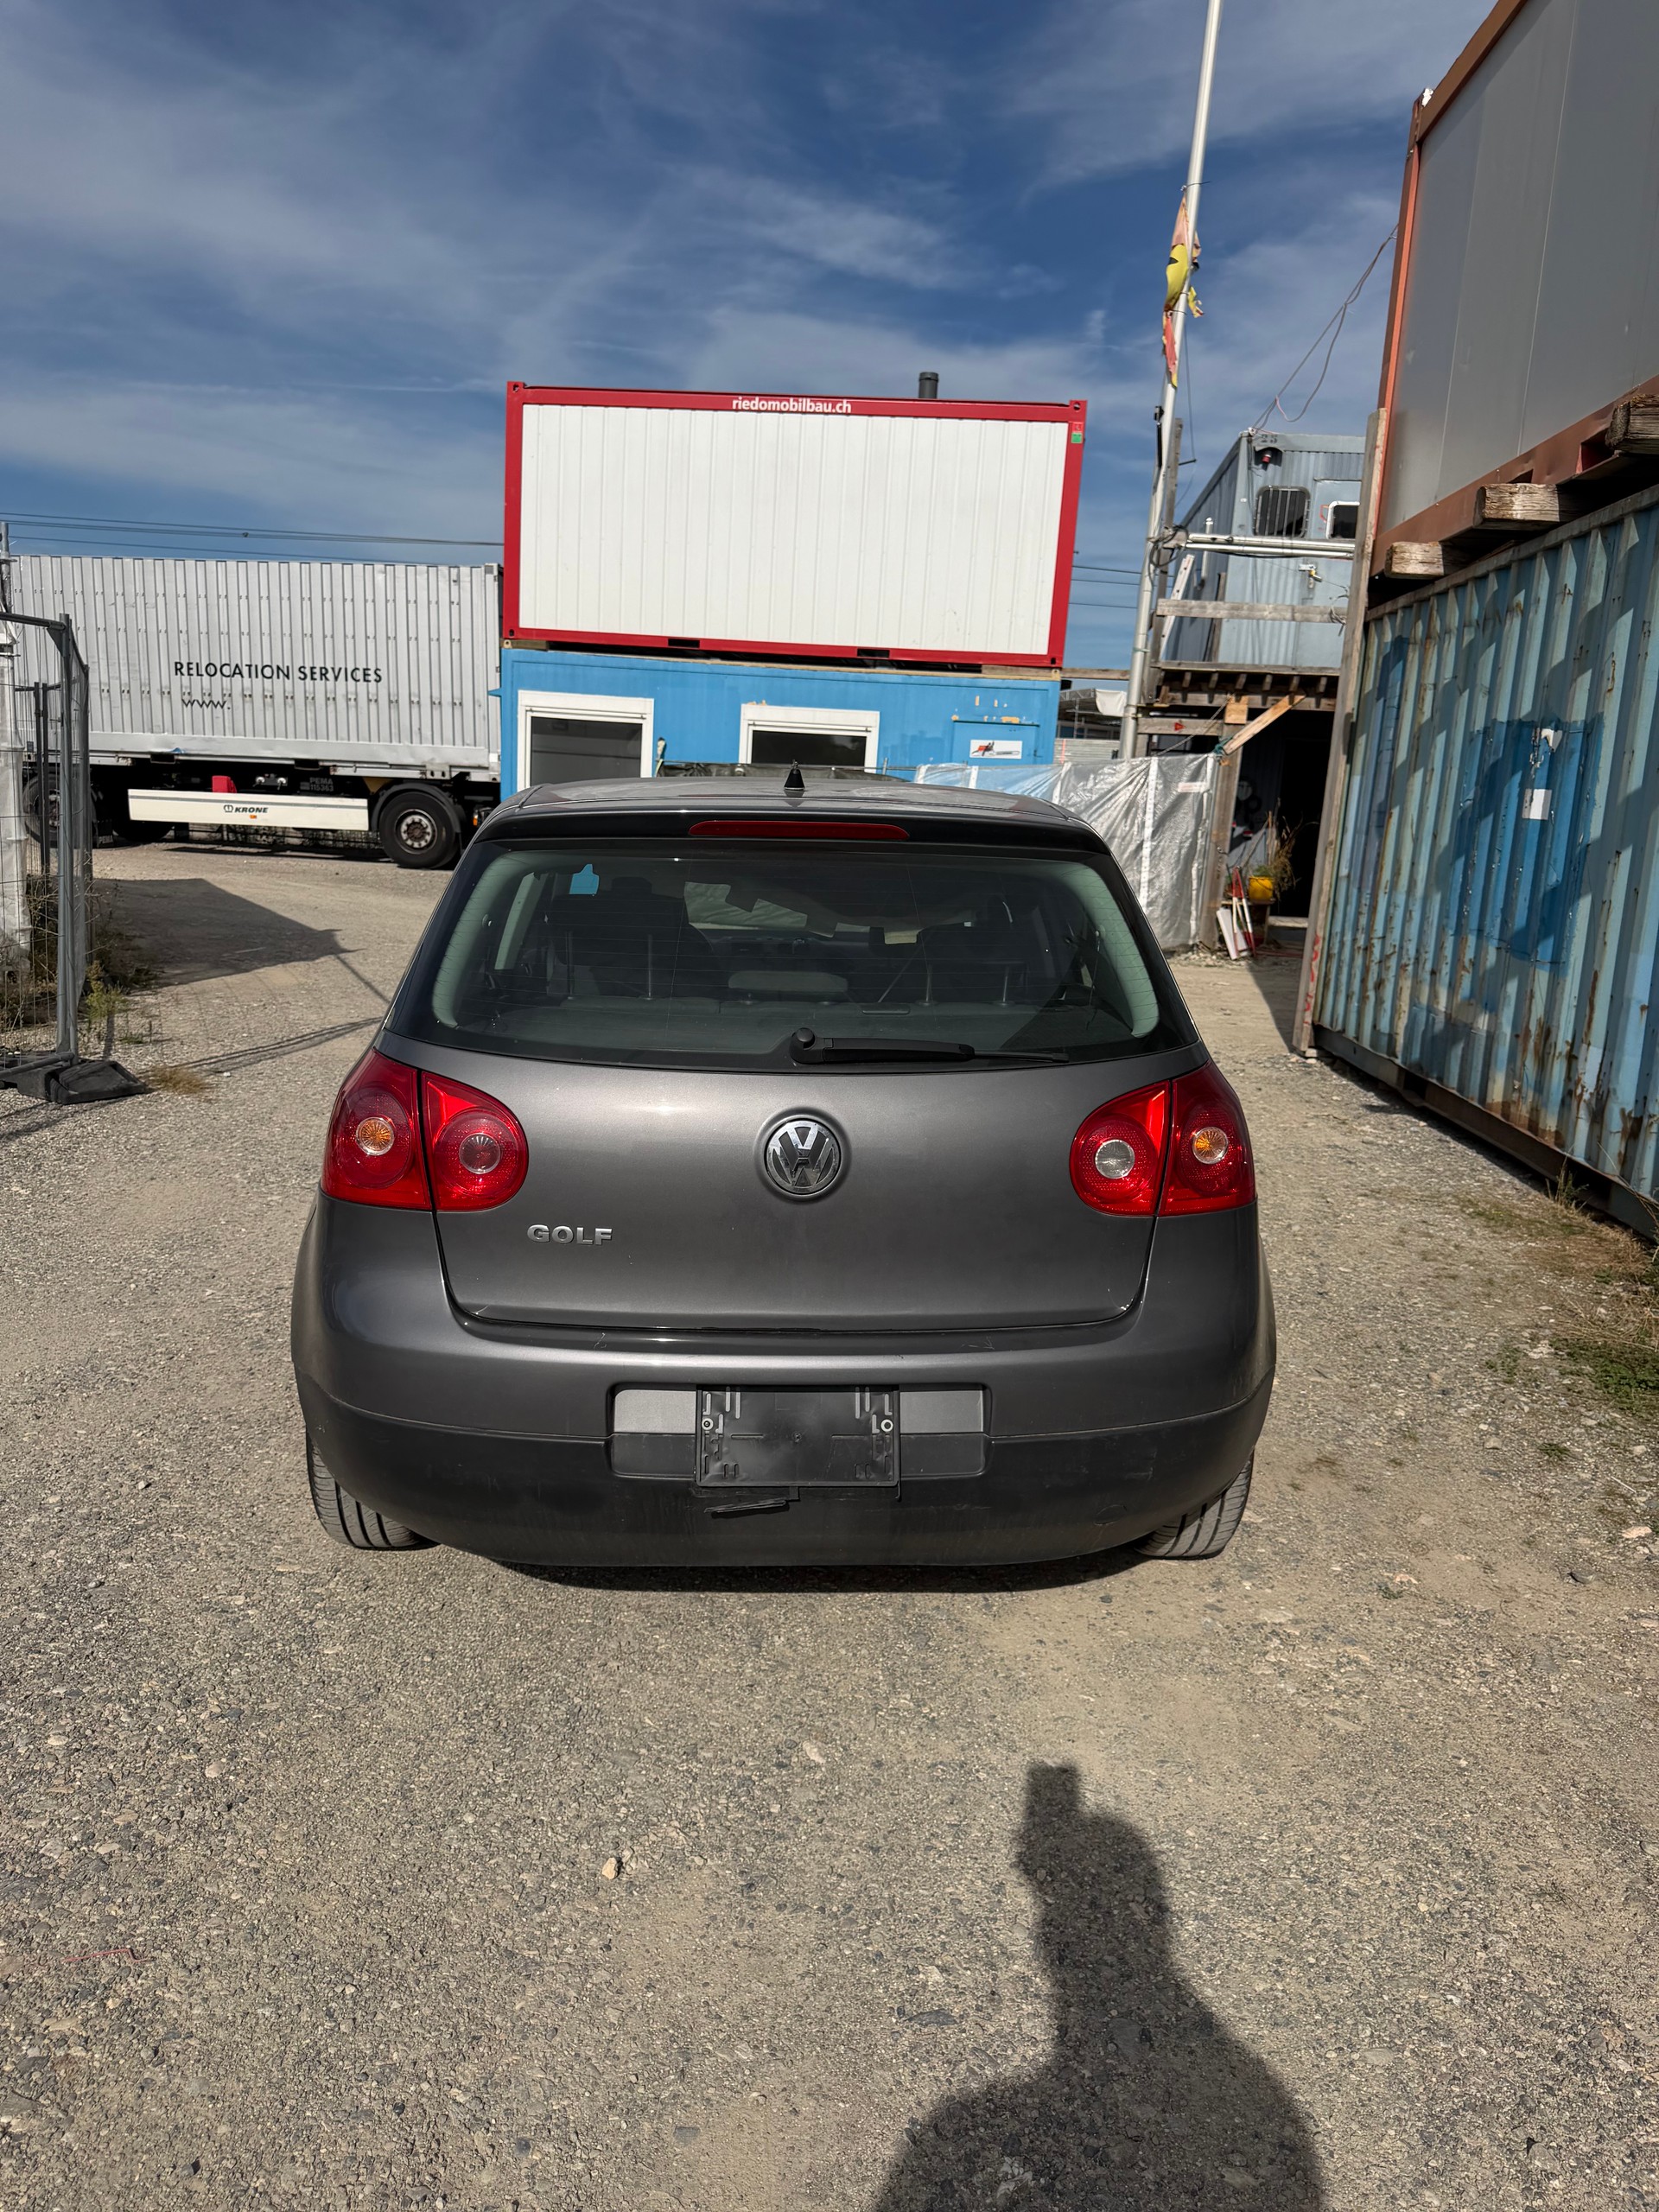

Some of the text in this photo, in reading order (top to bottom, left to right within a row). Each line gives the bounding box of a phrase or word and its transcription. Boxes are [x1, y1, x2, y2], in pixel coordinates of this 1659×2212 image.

[733, 396, 852, 413] riedomobilbau.ch
[175, 661, 383, 683] RELOCATION SERVICES
[181, 698, 231, 710] www.
[527, 1224, 613, 1246] GOLF
